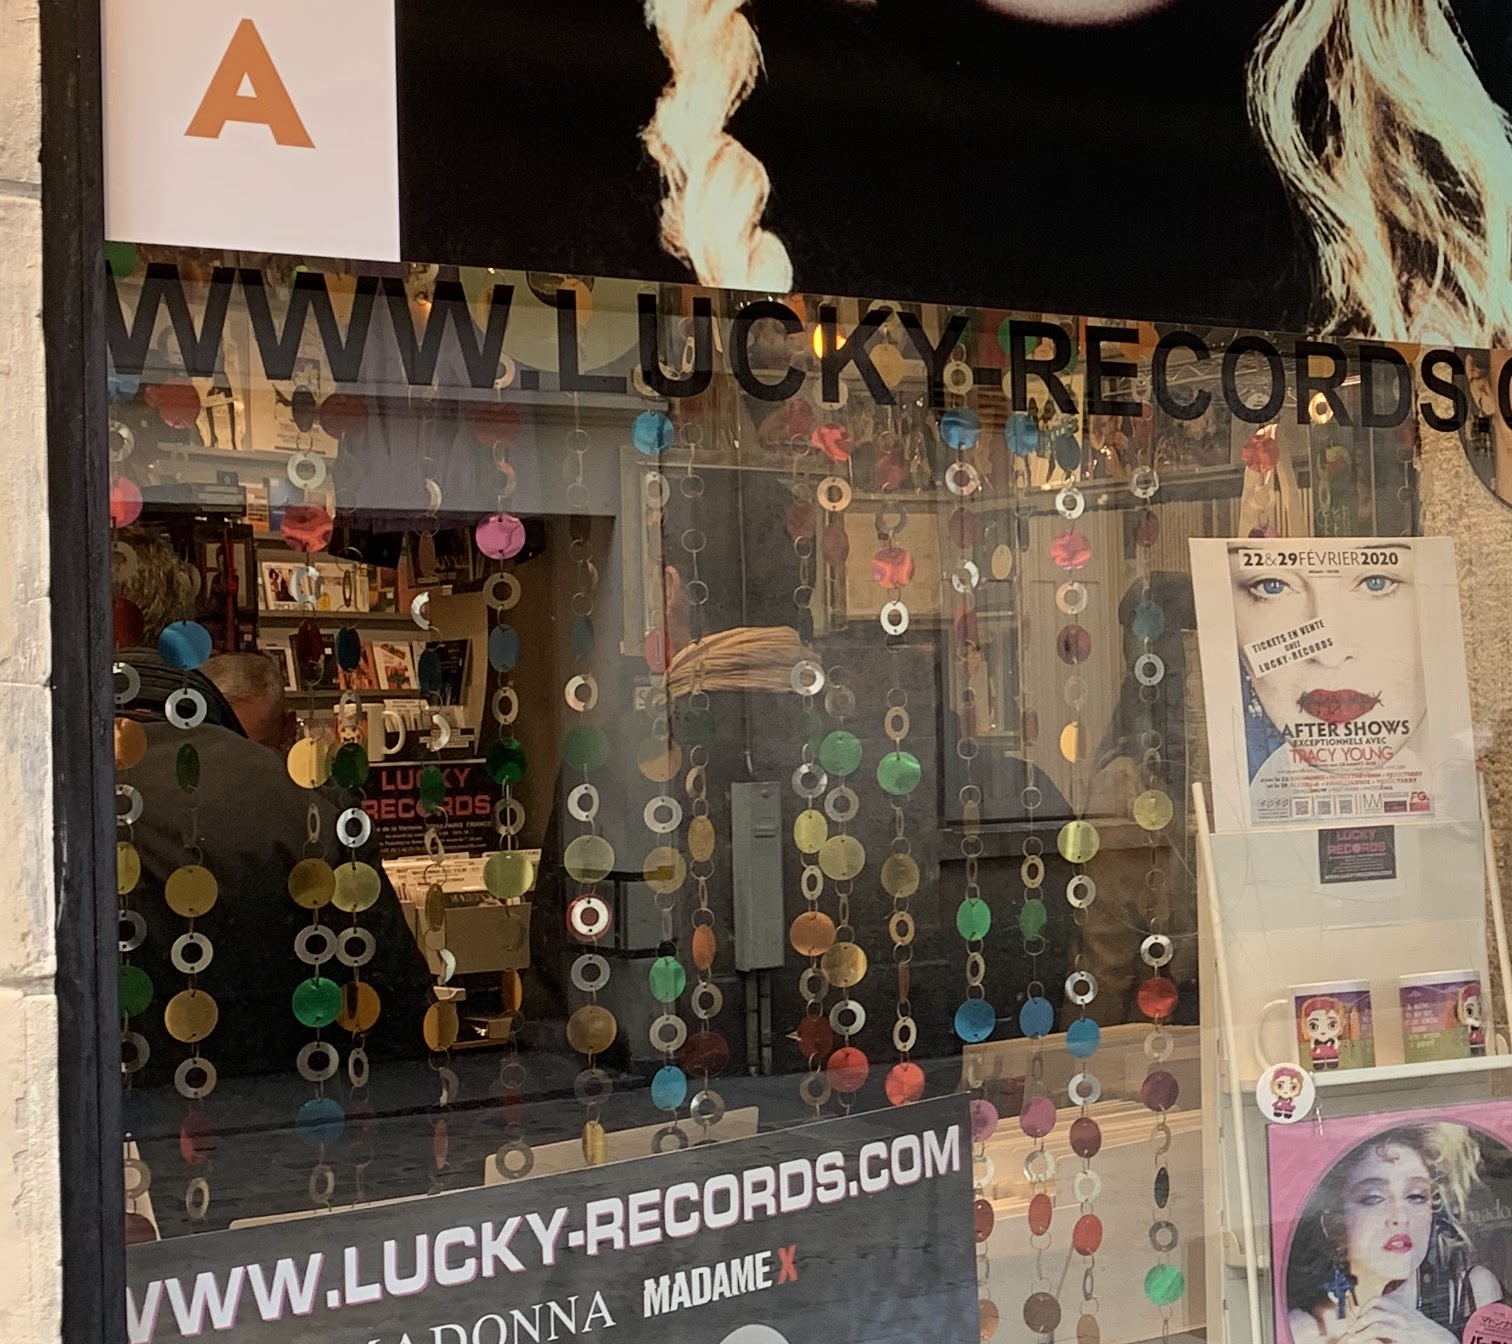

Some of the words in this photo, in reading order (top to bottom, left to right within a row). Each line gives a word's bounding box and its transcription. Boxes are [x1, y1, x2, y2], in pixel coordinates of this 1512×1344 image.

[1252, 633, 1287, 654] TICKETS
[1288, 628, 1299, 641] EN
[1299, 619, 1325, 637] VENTE
[1258, 637, 1334, 673] LUCKY-RECORDS
[1281, 721, 1340, 739] AFTER
[1344, 719, 1410, 736] SHOWS
[1365, 736, 1387, 745] AVEC
[1290, 748, 1338, 764] TRACY
[1341, 746, 1394, 762] YOUNG
[642, 1251, 772, 1320] MADAME
[777, 1244, 799, 1284] X
